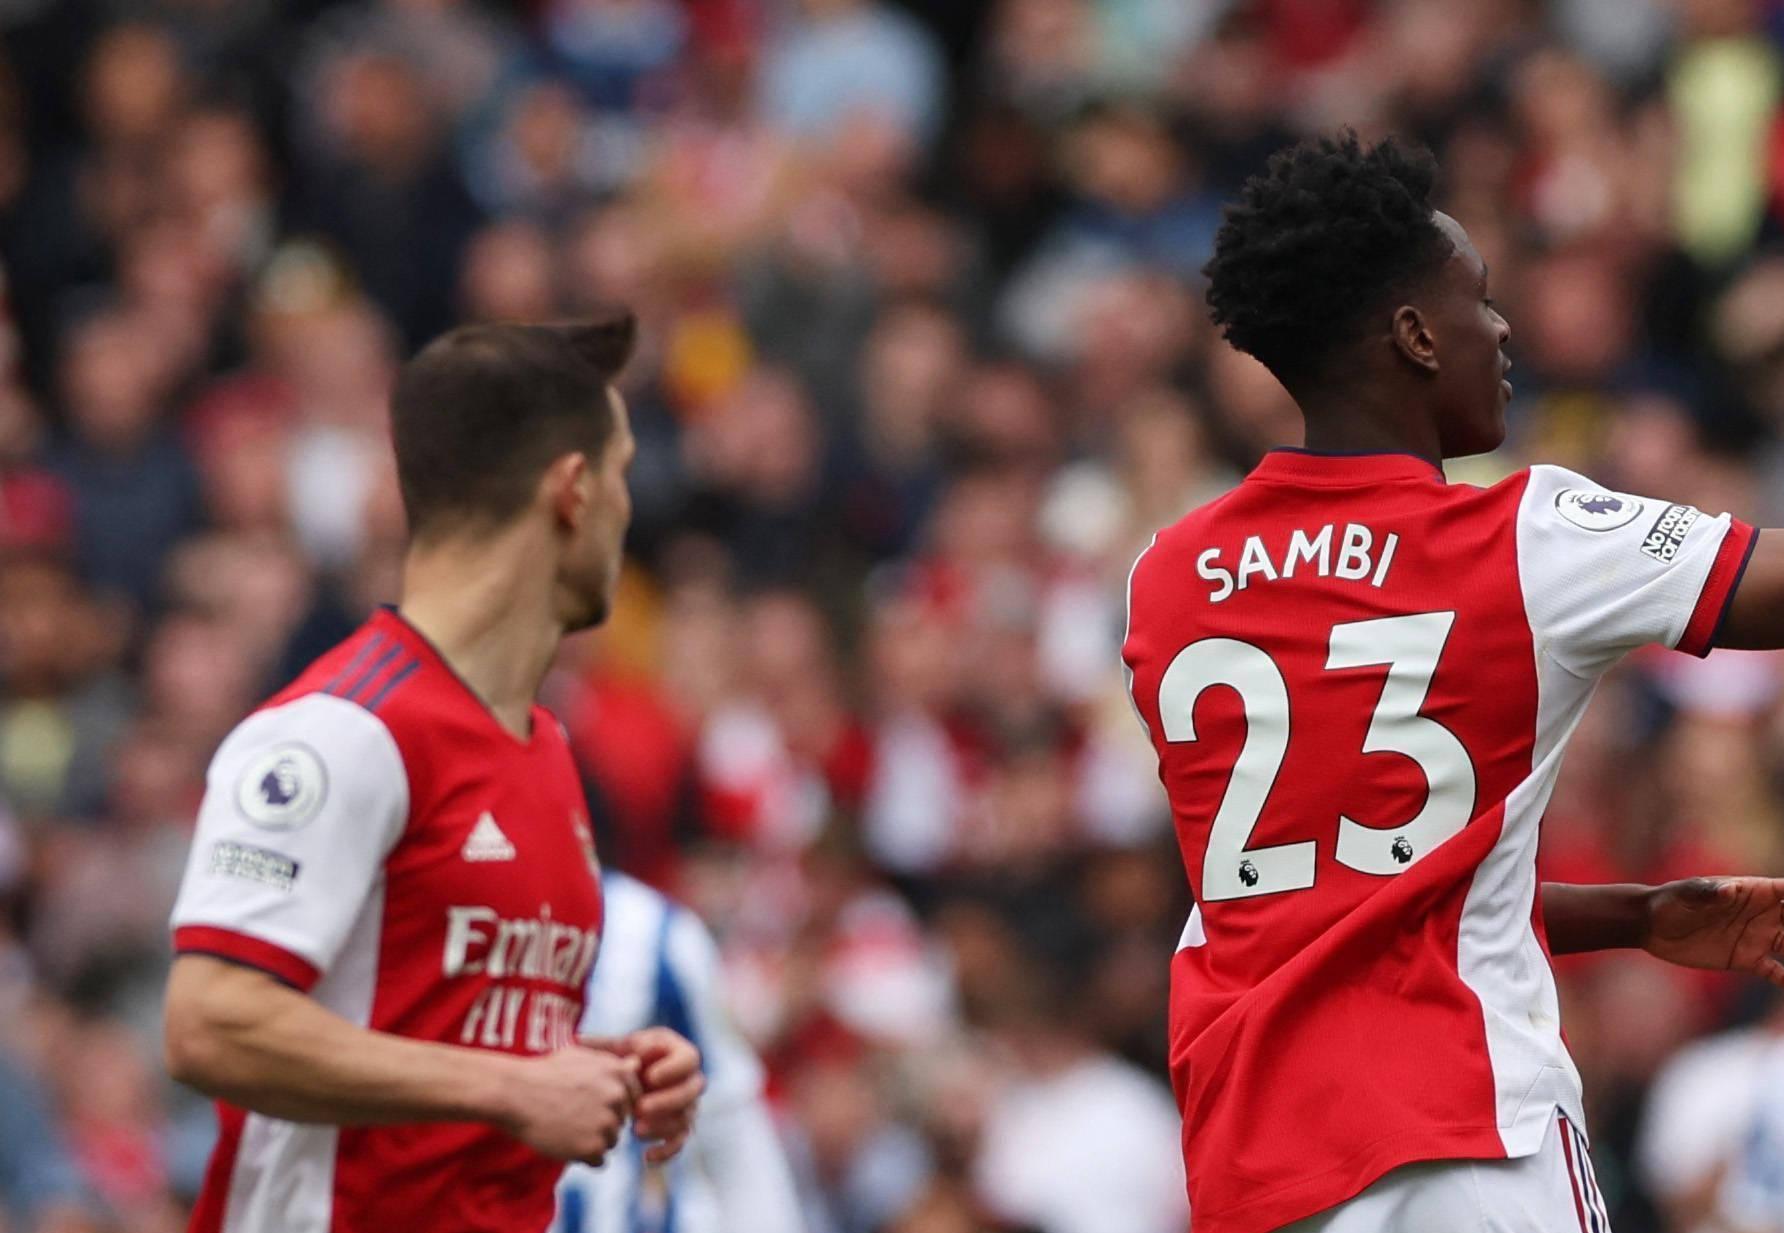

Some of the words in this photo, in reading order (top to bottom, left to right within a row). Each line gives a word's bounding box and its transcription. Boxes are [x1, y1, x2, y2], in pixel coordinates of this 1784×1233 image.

[1196, 523, 1399, 603] SAMBI
[1641, 532, 1666, 559] No
[1658, 506, 1687, 535] room
[1655, 538, 1678, 563] for
[1158, 610, 1477, 902] 23
